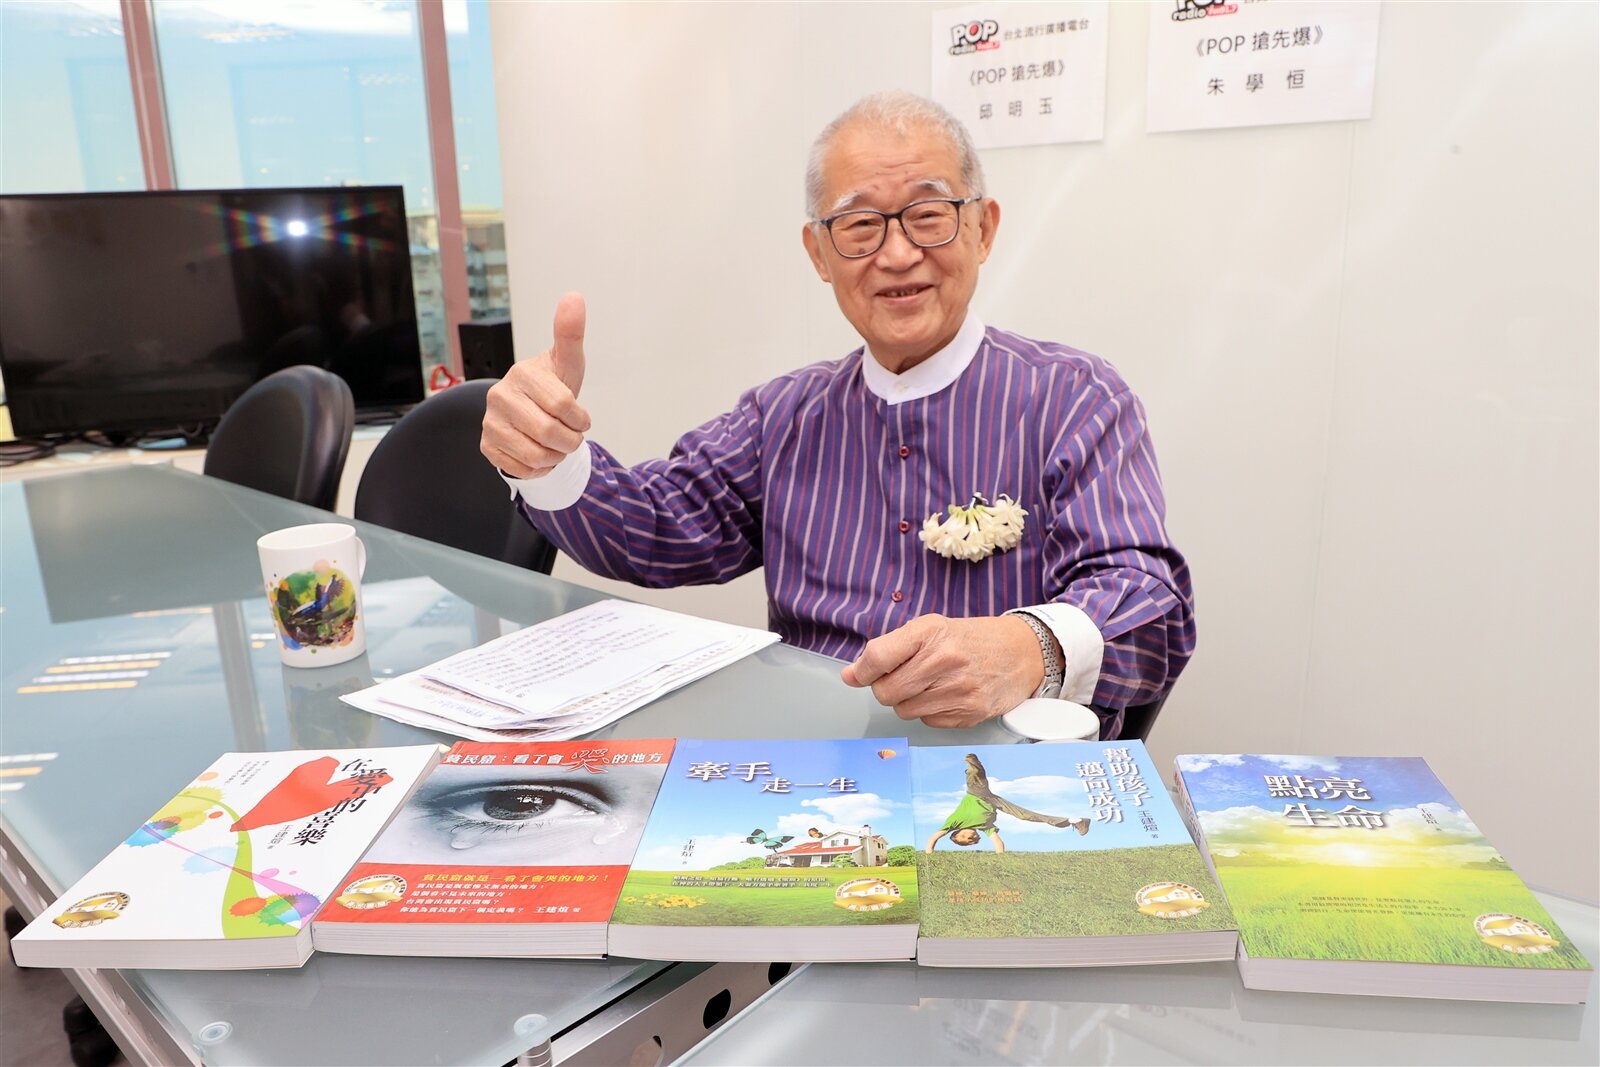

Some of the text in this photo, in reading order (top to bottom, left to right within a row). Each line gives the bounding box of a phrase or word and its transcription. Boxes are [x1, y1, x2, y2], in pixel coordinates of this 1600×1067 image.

[1172, 8, 1206, 21] radio
[950, 19, 999, 47] POP
[685, 761, 772, 782] 牽手
[1103, 747, 1153, 807] 幫助孩子
[760, 777, 859, 794] 走一生
[1075, 761, 1127, 824] 邁向成功
[1263, 774, 1373, 800] 點亮
[290, 758, 388, 846] 在愛中的喜樂
[1282, 802, 1386, 829] 生命
